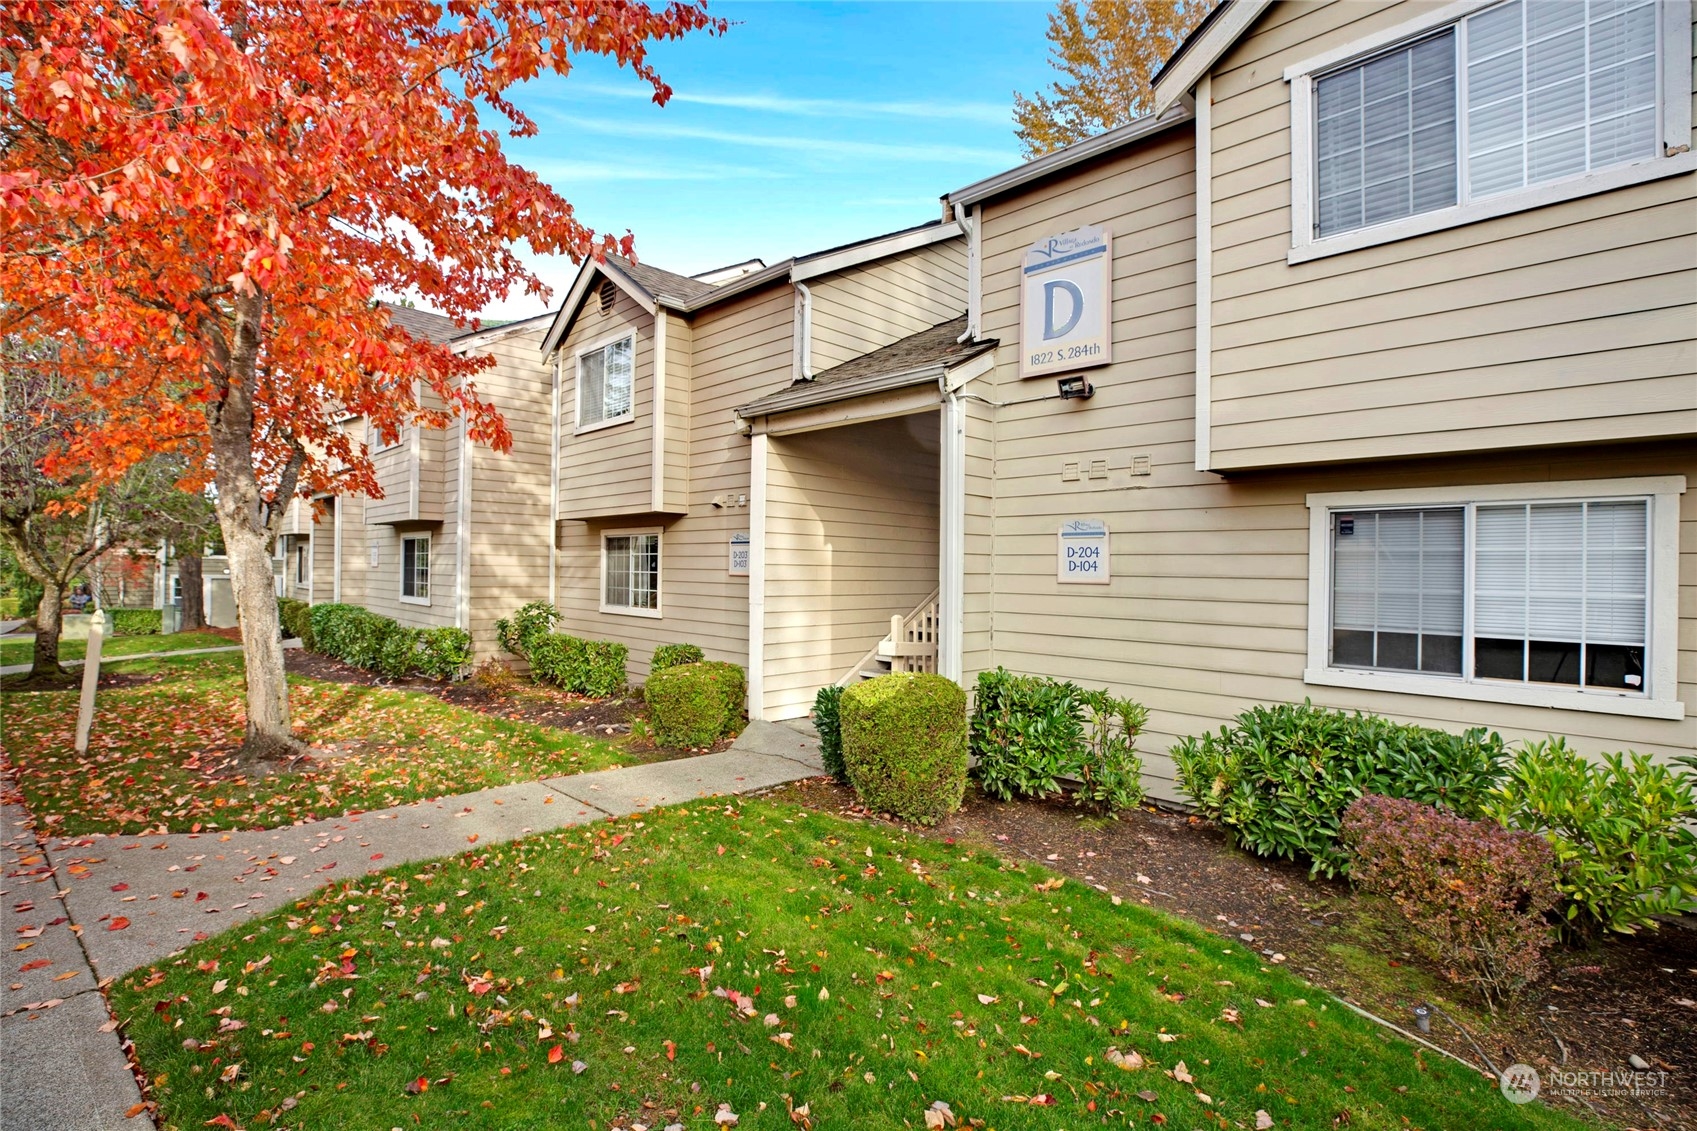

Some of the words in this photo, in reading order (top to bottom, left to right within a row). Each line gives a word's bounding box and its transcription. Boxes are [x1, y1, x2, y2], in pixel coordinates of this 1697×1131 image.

[1043, 279, 1084, 341] D
[1030, 352, 1053, 366] 1822
[1057, 349, 1066, 361] S.
[1068, 343, 1101, 360] 284th
[733, 551, 748, 559] D-203
[1067, 546, 1100, 558] D-204
[1069, 560, 1098, 572] D-104
